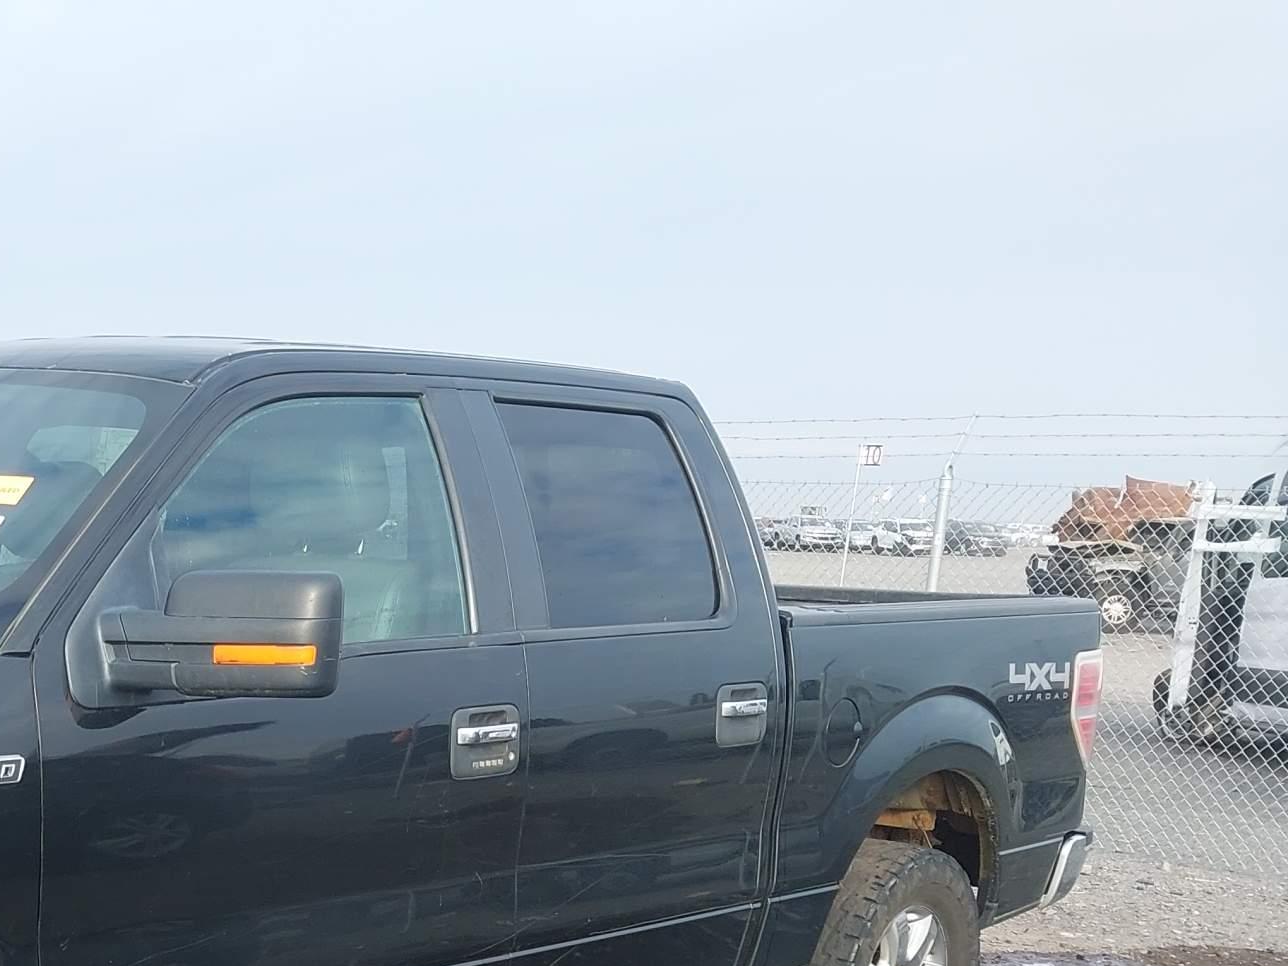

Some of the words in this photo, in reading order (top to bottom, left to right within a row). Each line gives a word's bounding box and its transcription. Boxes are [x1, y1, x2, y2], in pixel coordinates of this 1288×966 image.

[865, 446, 882, 464] 10
[1008, 662, 1071, 690] 4X4
[1007, 693, 1032, 703] OFF
[1036, 692, 1069, 701] ROAD
